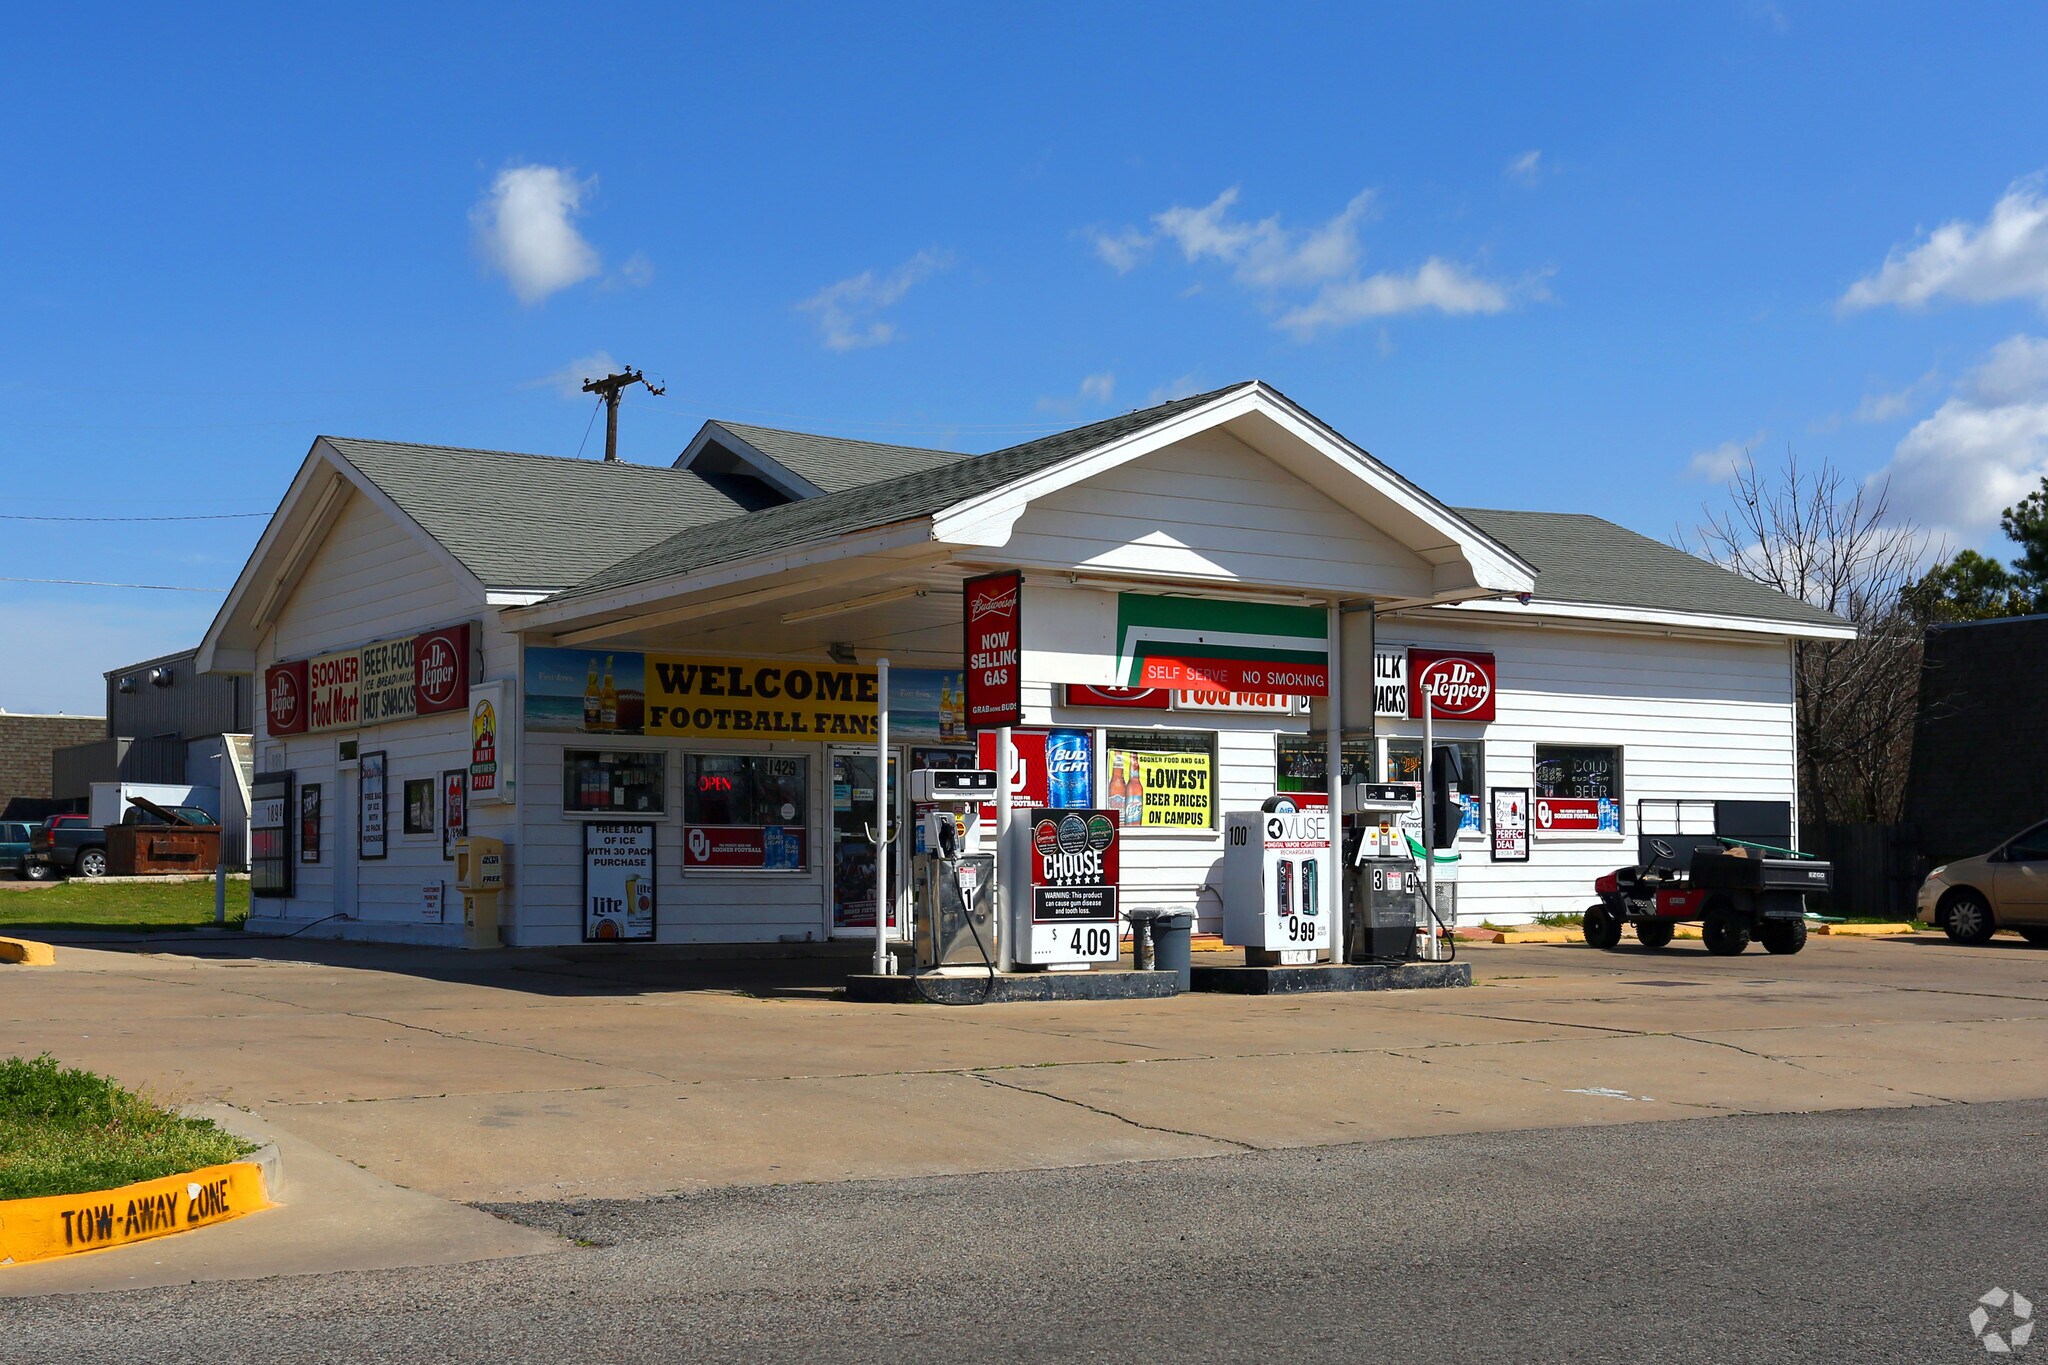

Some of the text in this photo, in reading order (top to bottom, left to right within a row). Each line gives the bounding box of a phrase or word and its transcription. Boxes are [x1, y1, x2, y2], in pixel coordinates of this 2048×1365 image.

[971, 597, 1016, 614] Budweiser
[981, 631, 1009, 650] NOW
[431, 645, 446, 667] Dr
[312, 657, 359, 688] SOONER
[1147, 665, 1229, 683] SELF SERVE
[1376, 653, 1403, 679] ILK
[1450, 663, 1475, 684] Dr
[364, 679, 374, 691] ICE
[420, 658, 454, 695] Pepper
[656, 663, 878, 703] WELCOME
[984, 669, 1008, 686] GAS
[1242, 671, 1324, 688] NO SMOKING
[278, 677, 290, 697] Dr
[1431, 673, 1487, 706] Pepper
[269, 687, 297, 720] Pepper
[311, 685, 359, 728] Food Mart
[363, 685, 416, 721] HOT SNACKS
[972, 705, 989, 714] GRAB
[650, 706, 878, 735] FOOTBALL FANS
[476, 749, 491, 761] HUNT
[1053, 749, 1087, 762] BUD
[471, 763, 495, 774] BROTHERS
[768, 759, 796, 776] 1429
[1049, 761, 1089, 773] LIGHT
[1574, 760, 1608, 773] COLD
[474, 776, 493, 788] PIZZA
[699, 776, 732, 792] OPEN
[1146, 768, 1207, 790] LOWEST
[365, 792, 374, 800] FREE
[1575, 785, 1608, 798] BEER
[1145, 793, 1208, 808] BEER PRICES
[1497, 799, 1501, 810] 2
[1149, 811, 1203, 825] ON CAMPUS
[596, 826, 643, 834] FREE BAG
[1283, 817, 1325, 839] VUSE
[1496, 830, 1526, 839] PERFECT
[1229, 826, 1247, 849] 100
[1496, 840, 1514, 849] DEAL
[628, 848, 652, 856] PACK
[594, 858, 646, 866] PURCHASE
[1044, 851, 1104, 879] CHOOSE
[482, 875, 501, 883] FREE
[1374, 871, 1382, 889] 3
[1407, 874, 1414, 892] 4
[637, 885, 652, 896] Lite
[965, 889, 971, 909] 1
[1083, 891, 1103, 899] product
[592, 896, 623, 918] Lite
[1289, 916, 1315, 941] 9.99
[1052, 928, 1110, 956] $ 4.09
[61, 1179, 230, 1246] TOW-AWAY ZONE
